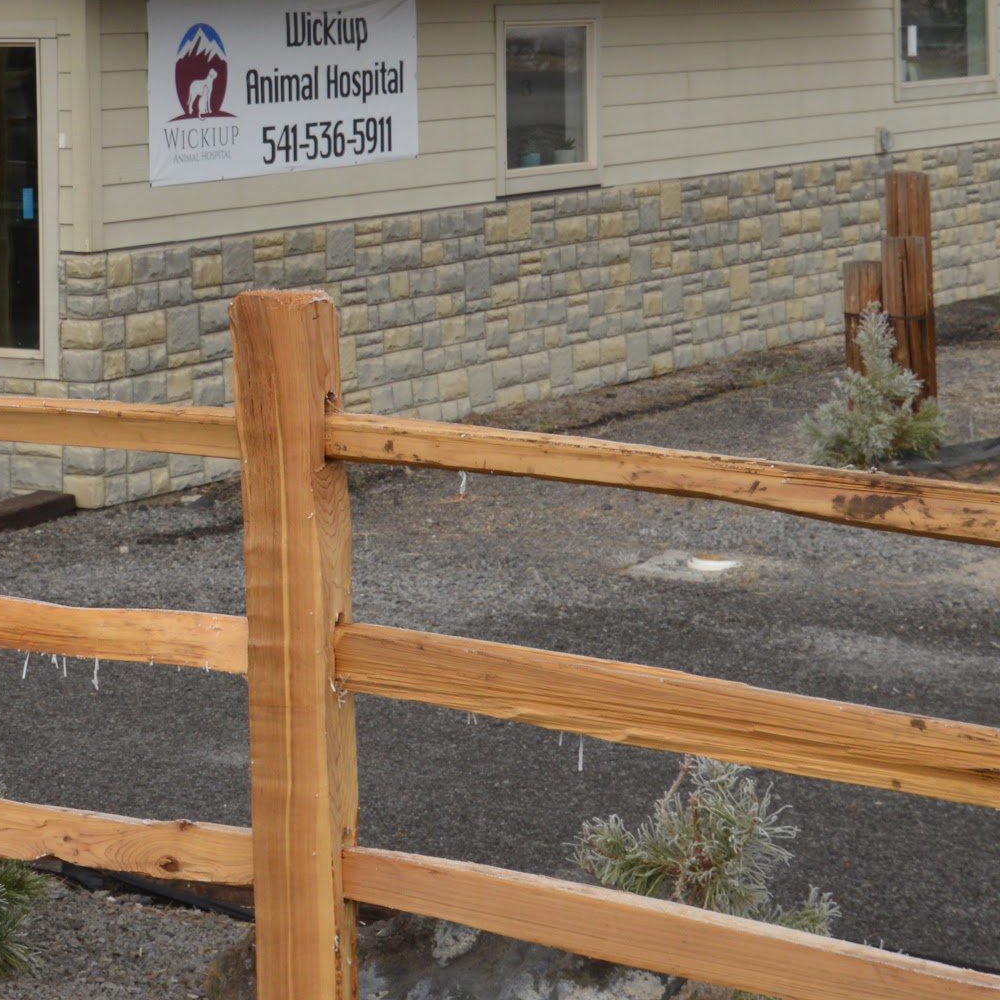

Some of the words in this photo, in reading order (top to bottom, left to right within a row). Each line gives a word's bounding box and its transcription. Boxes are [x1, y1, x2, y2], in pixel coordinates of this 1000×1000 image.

[285, 10, 369, 51] Wickiup
[246, 65, 319, 105] Animal
[326, 60, 404, 104] Hospital
[163, 125, 239, 150] WICKIUP
[173, 153, 199, 164] ANIMAL
[201, 150, 232, 161] HOSPITAL
[262, 116, 393, 165] 541-536-5911
